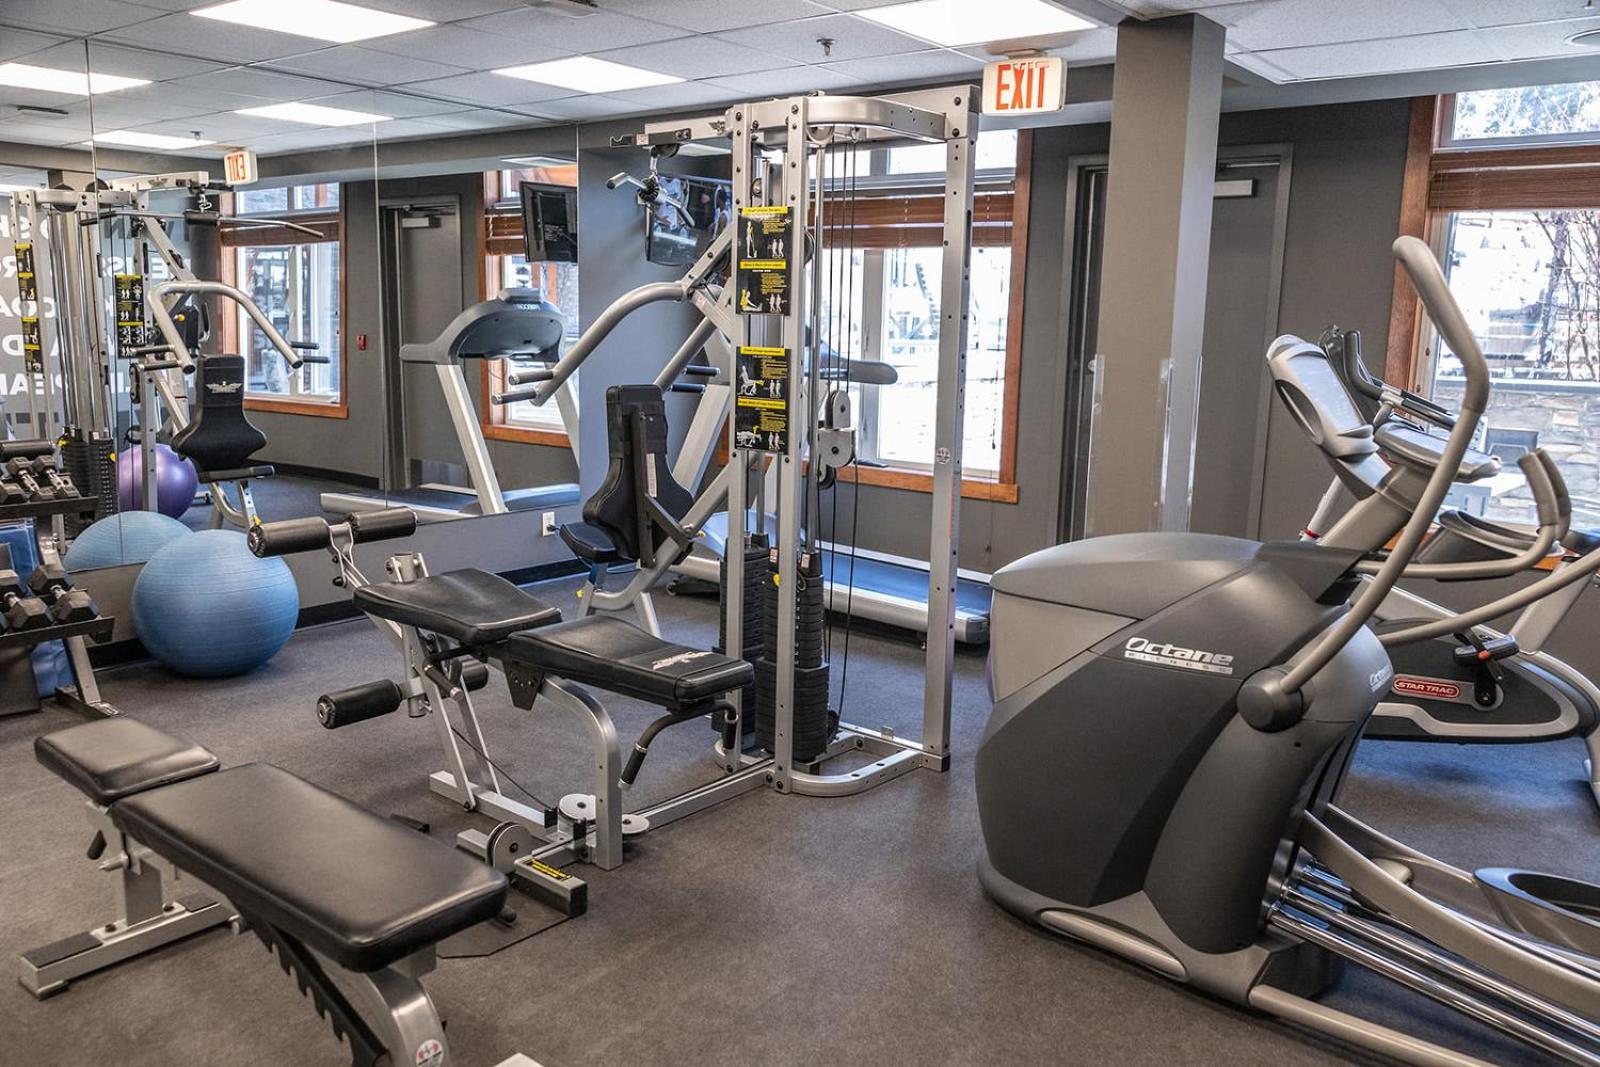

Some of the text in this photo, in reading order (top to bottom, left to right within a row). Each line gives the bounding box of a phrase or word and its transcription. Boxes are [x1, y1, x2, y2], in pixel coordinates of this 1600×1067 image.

[995, 62, 1049, 110] EXIT
[1126, 637, 1234, 665] Octane
[1397, 681, 1424, 691] STAR
[1426, 685, 1455, 694] TRAC
